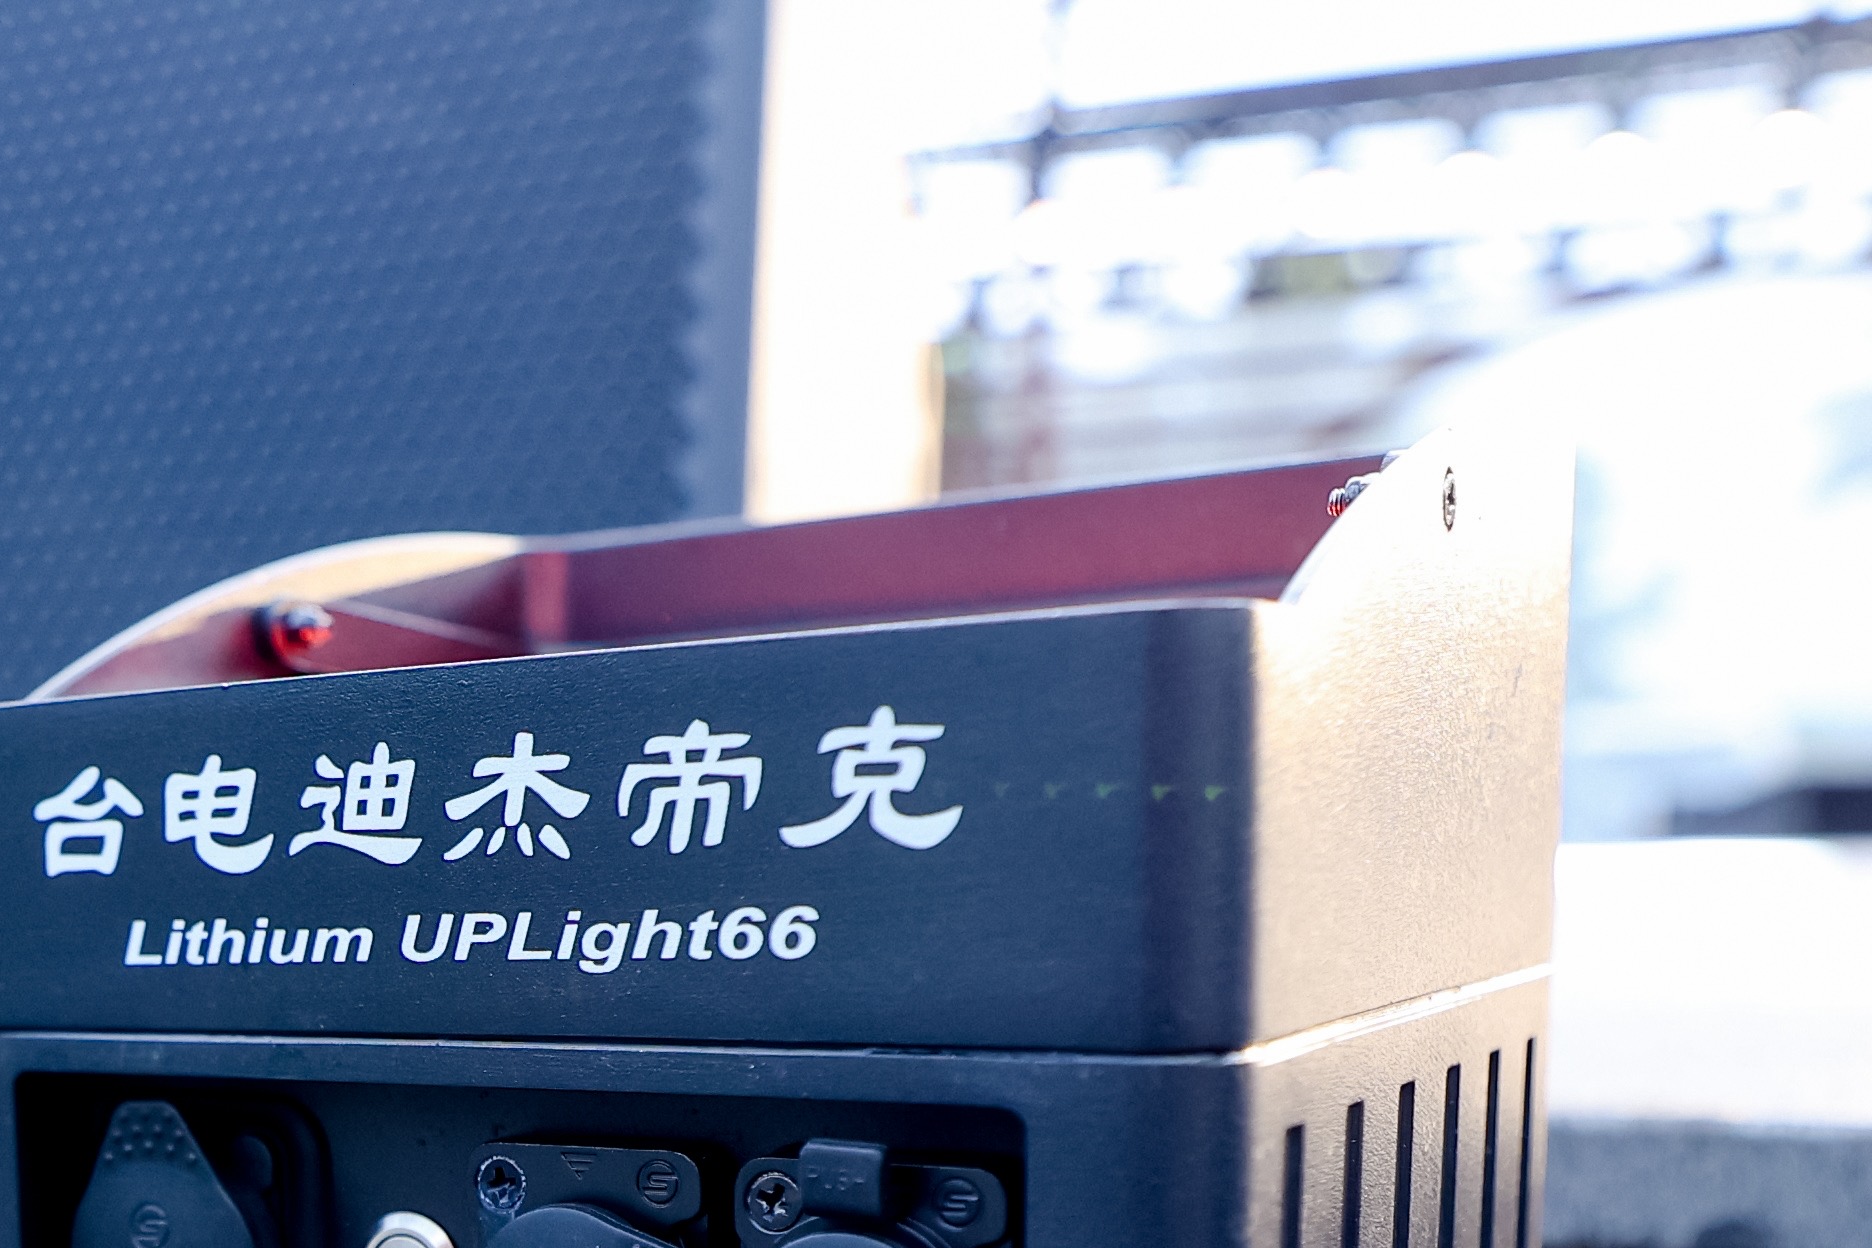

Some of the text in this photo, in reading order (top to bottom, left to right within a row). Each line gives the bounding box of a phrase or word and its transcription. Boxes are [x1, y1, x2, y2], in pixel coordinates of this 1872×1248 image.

[33, 705, 964, 878] 台电迪杰帝克
[124, 904, 820, 974] Lithium UPLight66
